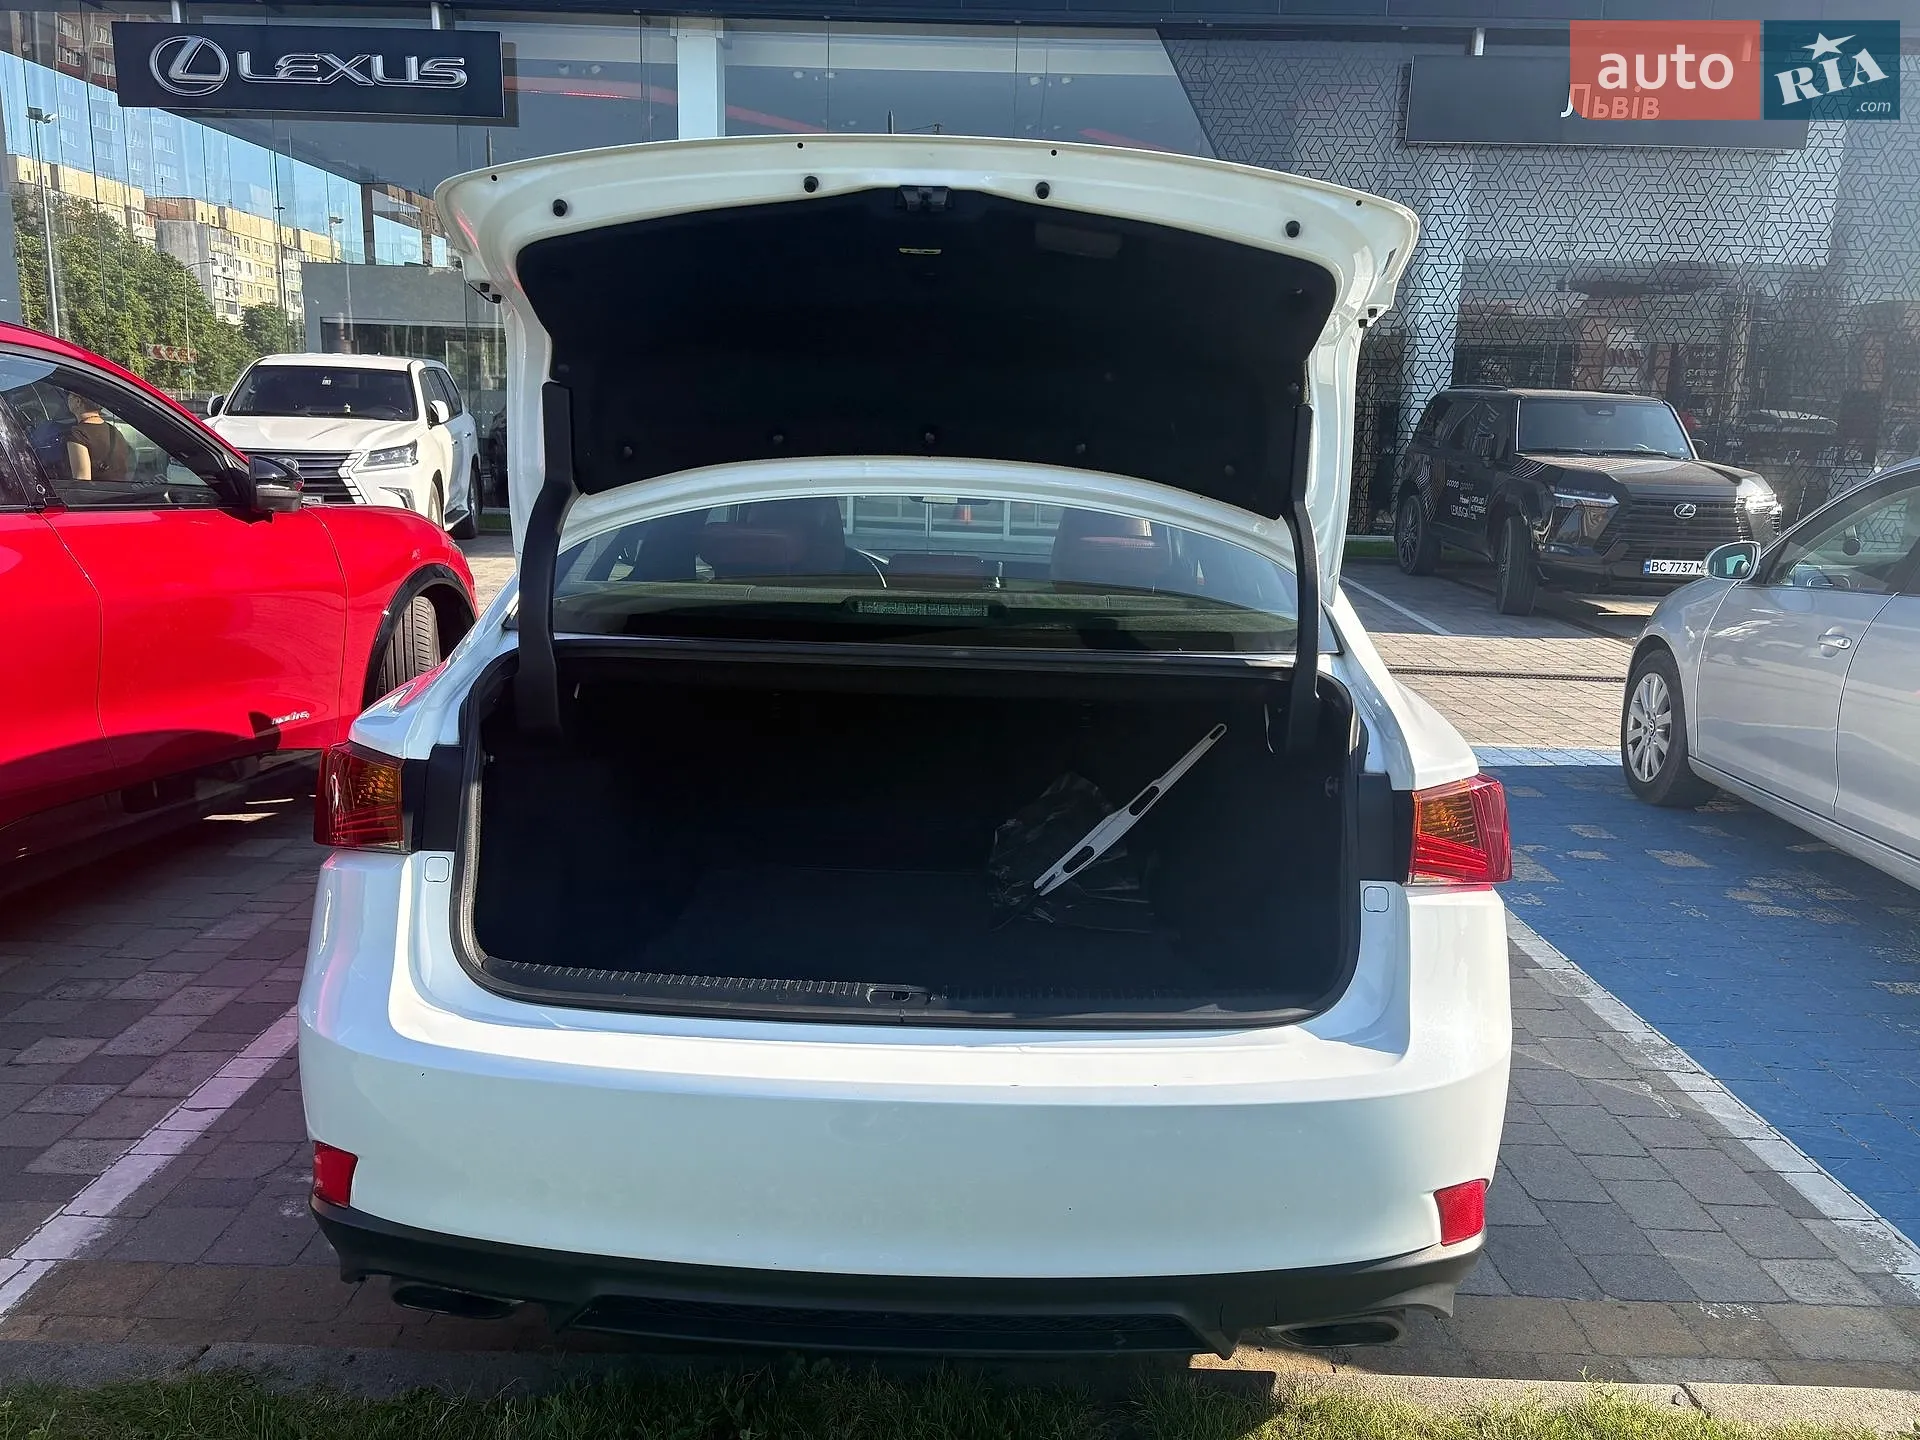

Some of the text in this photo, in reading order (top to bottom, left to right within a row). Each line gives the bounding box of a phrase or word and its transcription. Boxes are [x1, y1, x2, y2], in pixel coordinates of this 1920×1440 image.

[236, 50, 468, 90] LEXUS
[1560, 83, 1661, 119] Львів
[1651, 561, 1667, 572] BC
[1669, 562, 1694, 573] 7737
